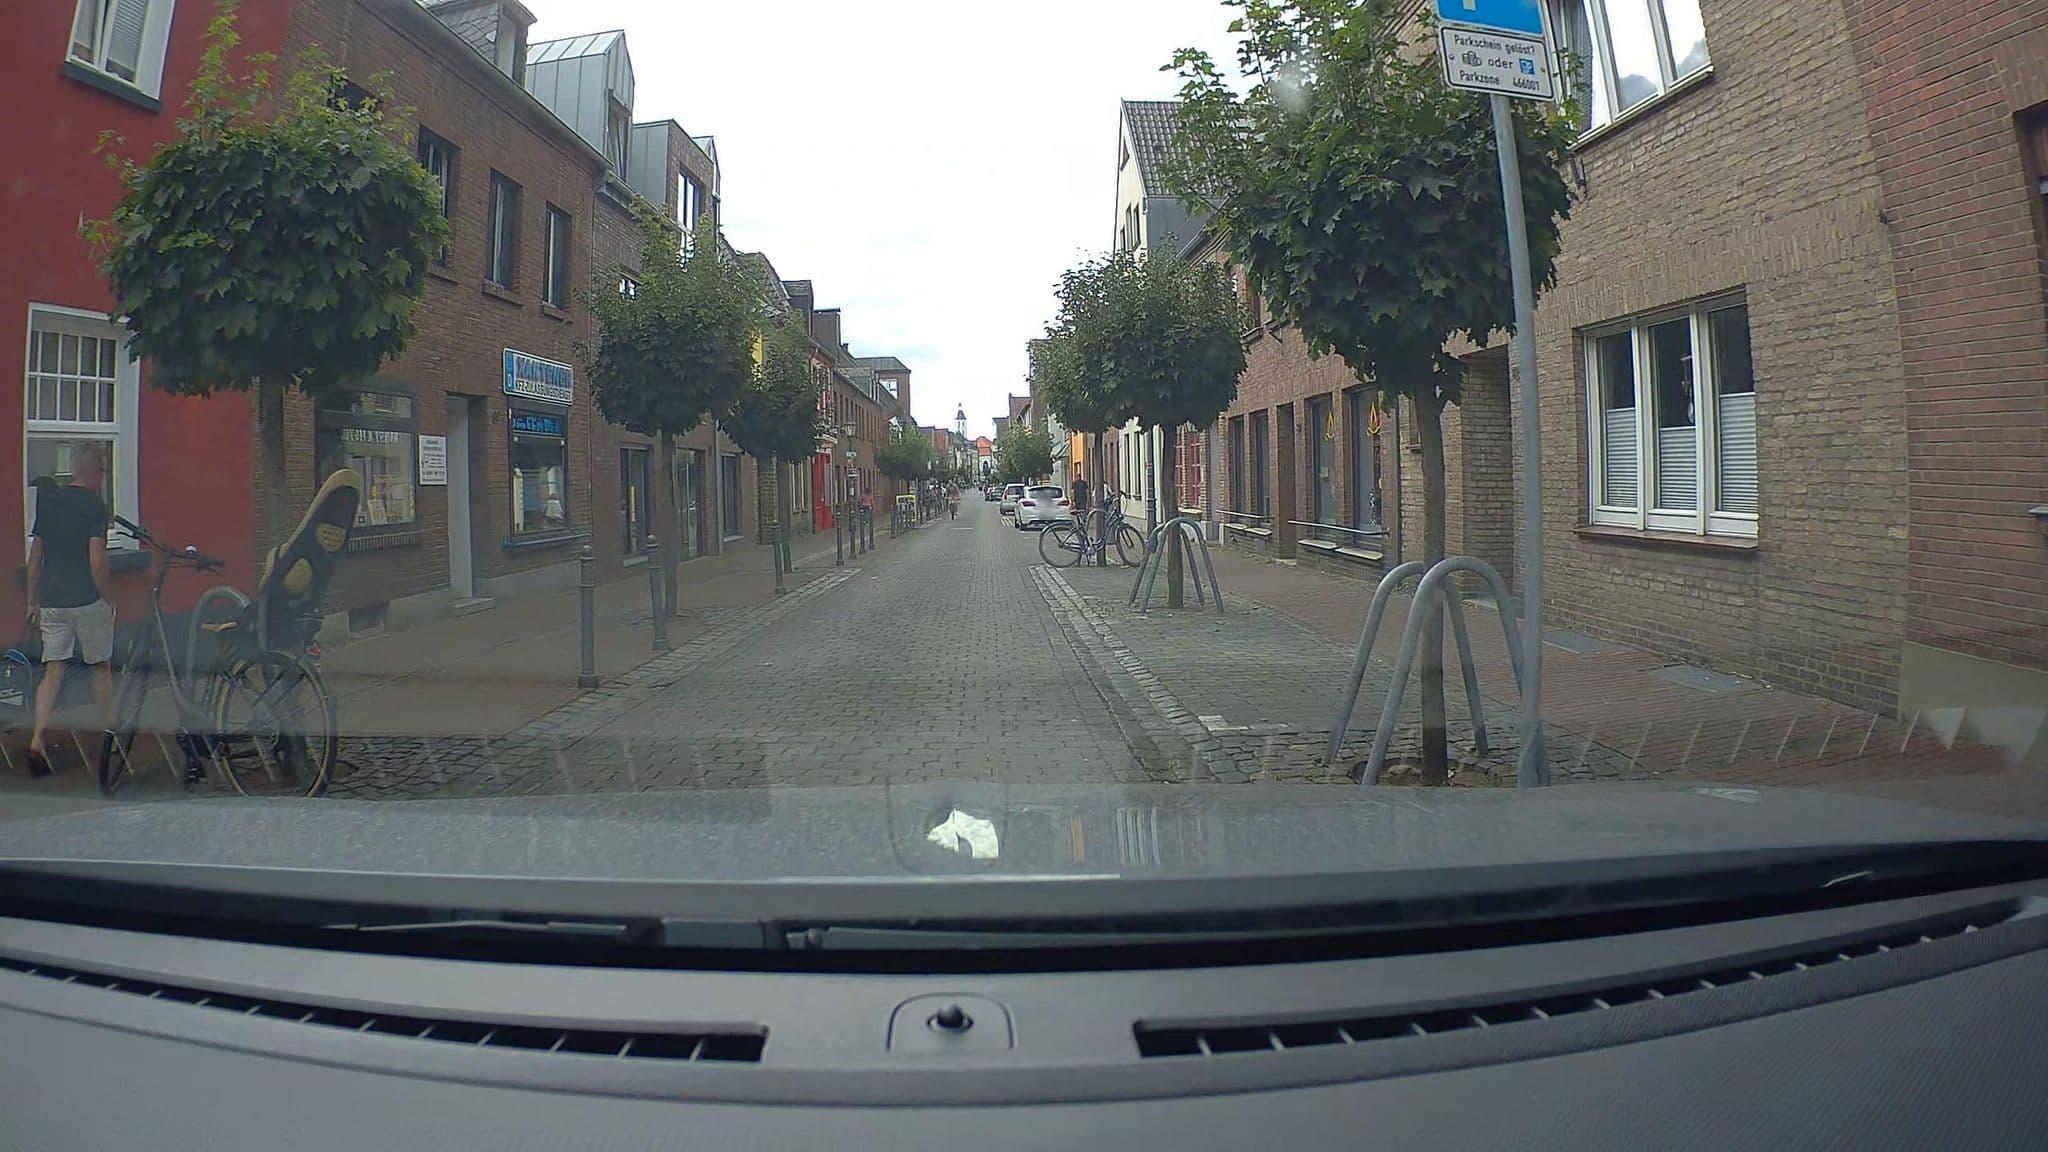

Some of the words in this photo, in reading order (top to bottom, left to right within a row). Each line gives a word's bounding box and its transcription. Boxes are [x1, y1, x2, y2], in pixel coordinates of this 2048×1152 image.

[1454, 34, 1502, 51] Parkschein
[1505, 43, 1535, 56] gelöst?
[1487, 57, 1514, 70] oder
[1459, 69, 1501, 86] Parkzone
[1512, 77, 1540, 91] 466001
